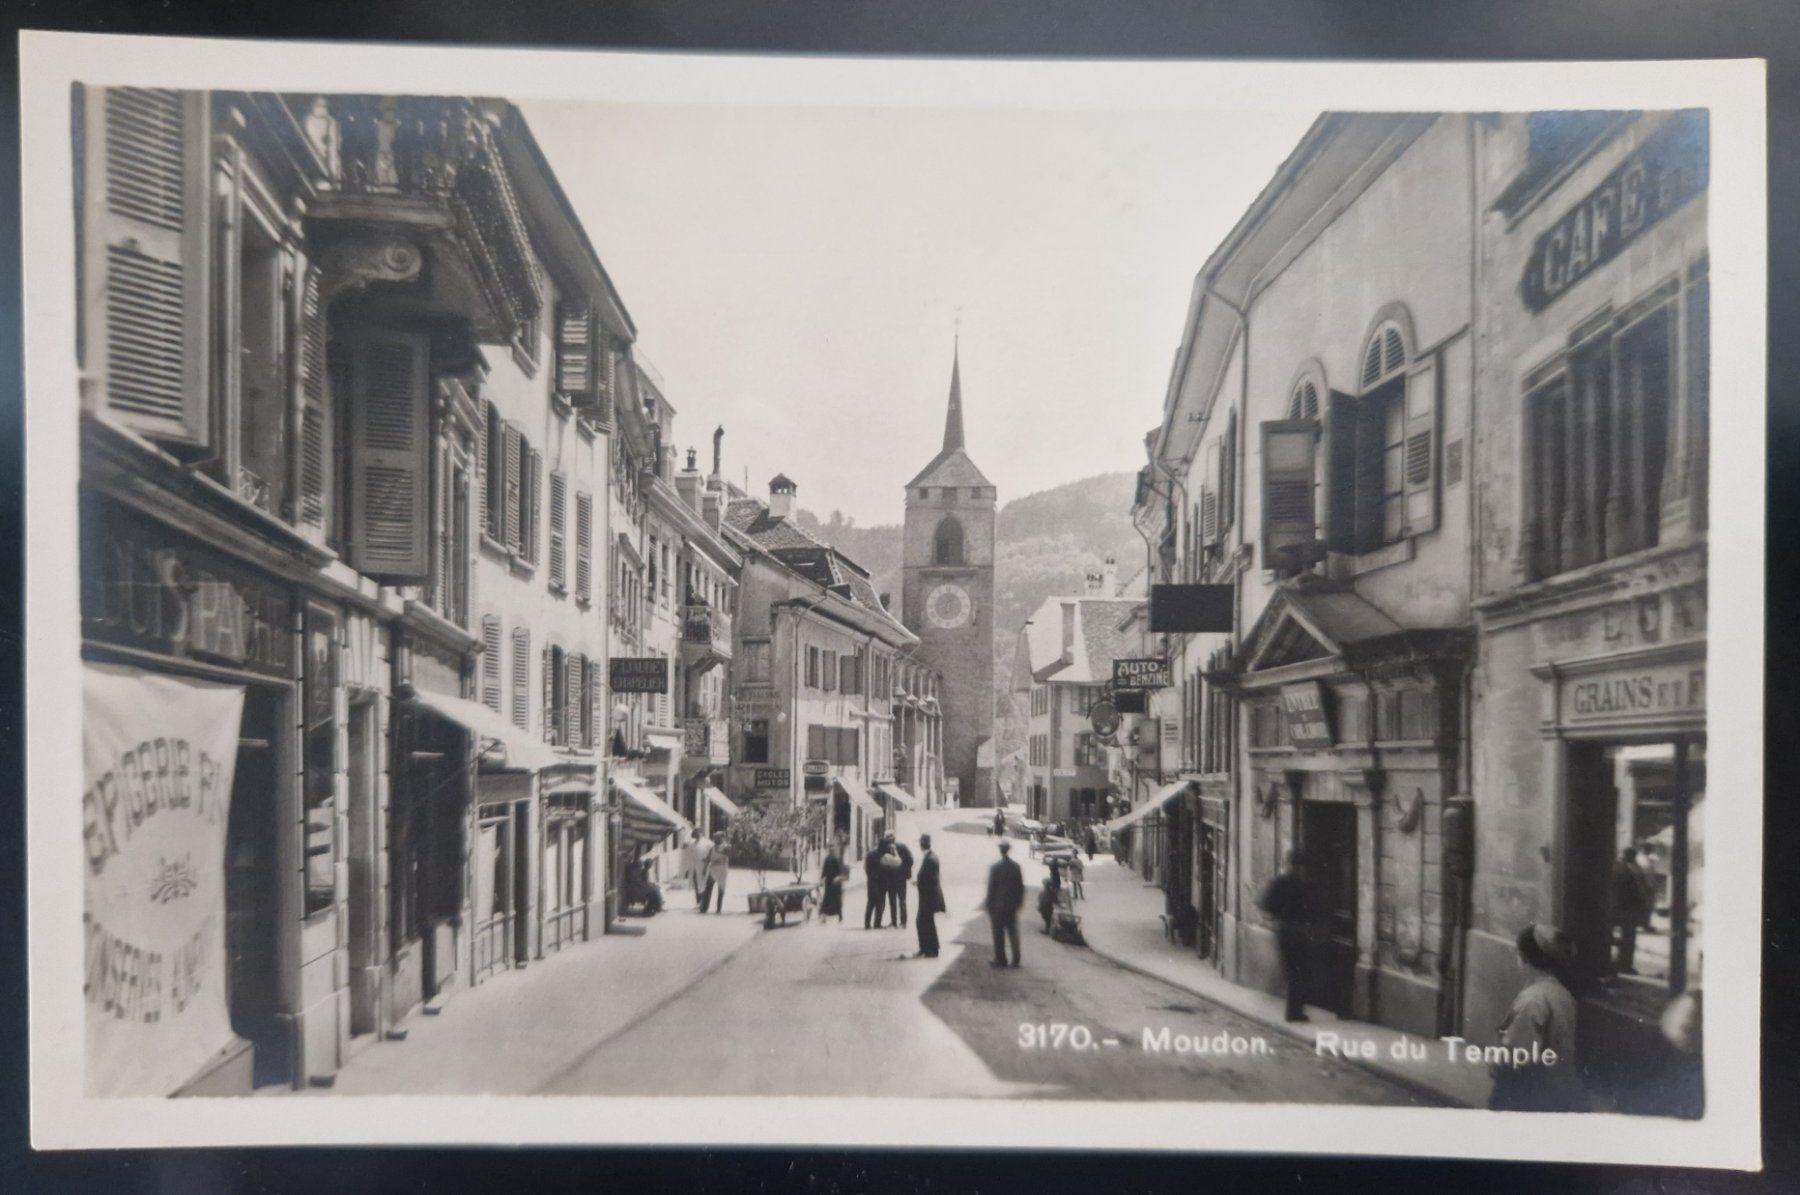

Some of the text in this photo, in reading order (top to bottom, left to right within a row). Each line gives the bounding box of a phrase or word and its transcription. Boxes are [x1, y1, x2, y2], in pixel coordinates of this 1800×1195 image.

[1129, 669, 1168, 686] BENZINE
[1574, 676, 1652, 714] GRAINS
[1657, 680, 1682, 707] ET
[757, 779, 789, 787] MOTOS
